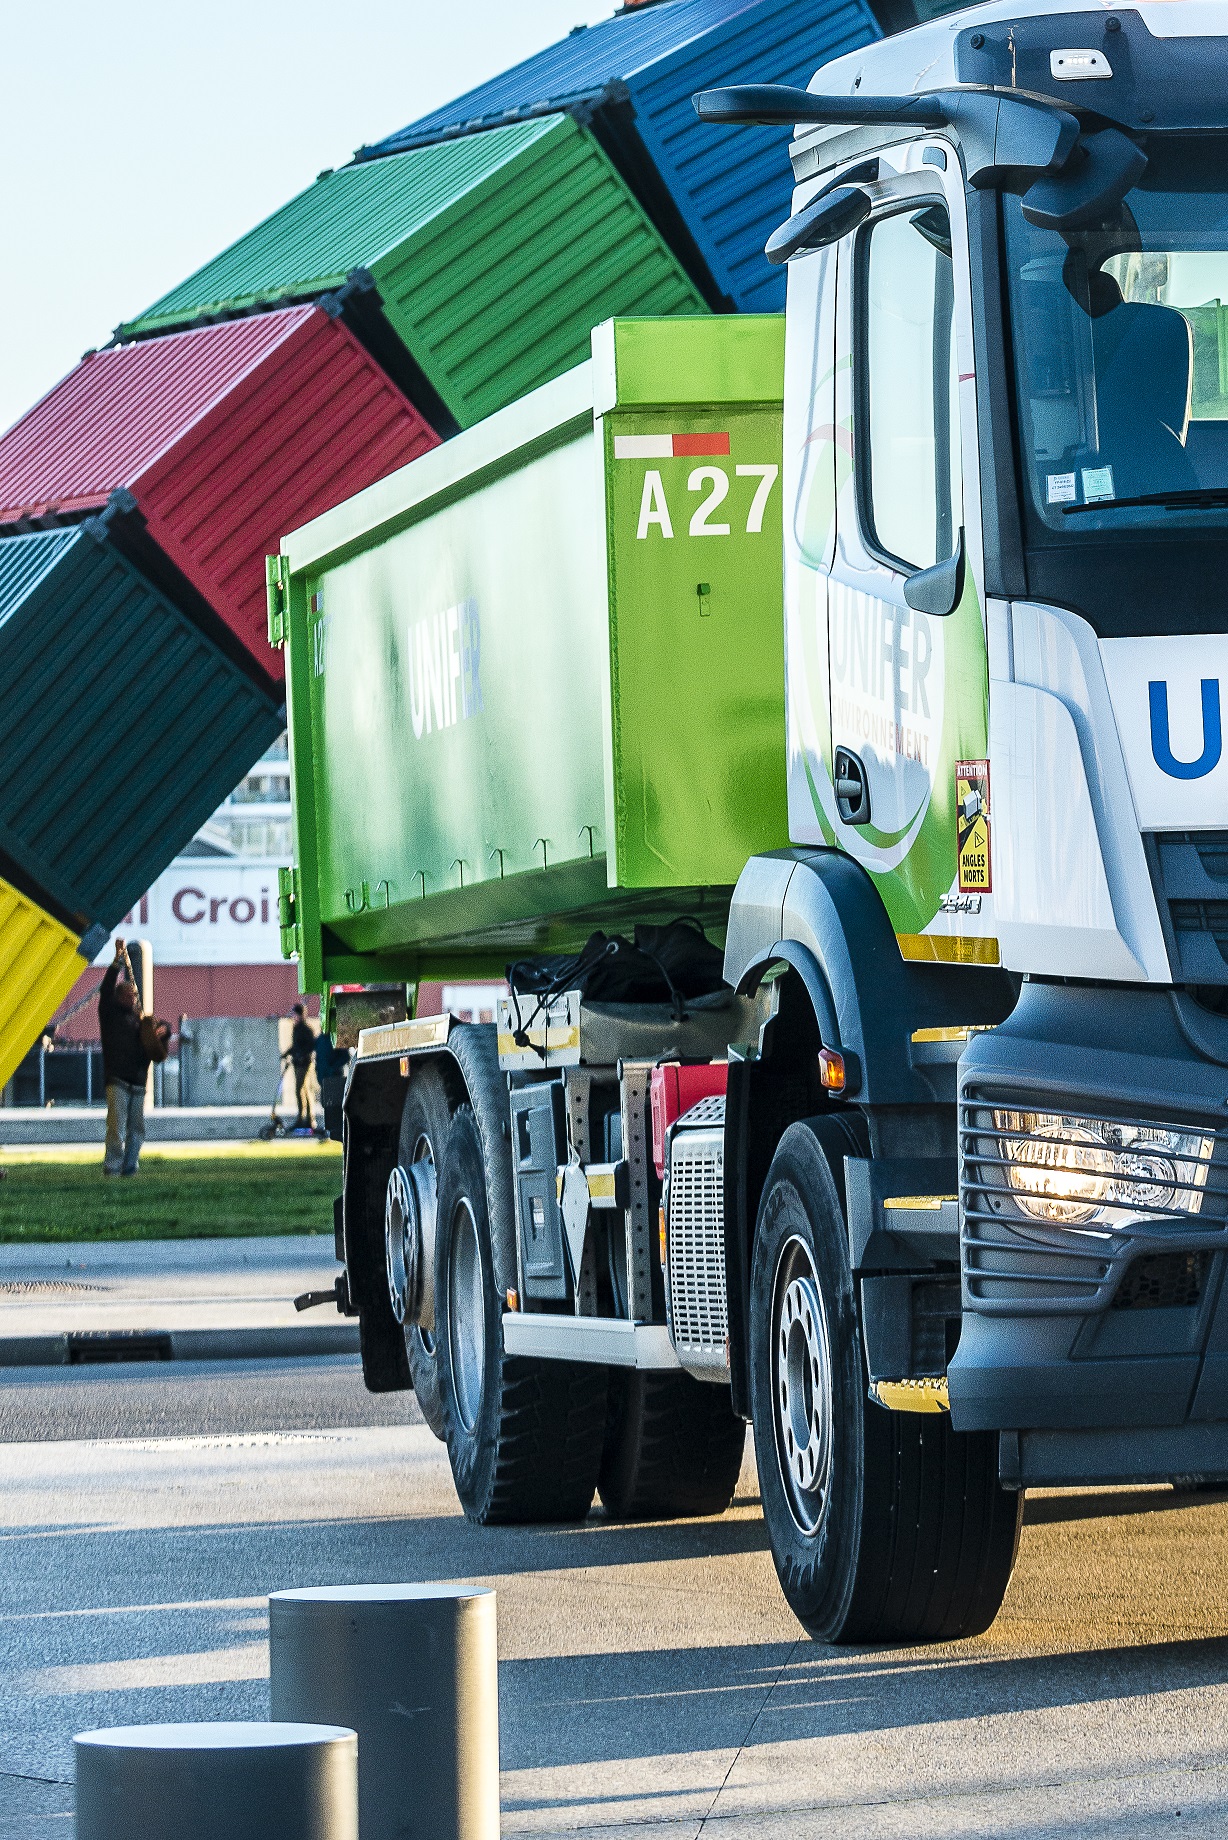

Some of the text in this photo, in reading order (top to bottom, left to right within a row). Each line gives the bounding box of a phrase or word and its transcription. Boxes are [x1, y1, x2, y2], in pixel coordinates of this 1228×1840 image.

[636, 463, 779, 540] A27
[407, 595, 485, 740] UNIFER
[831, 580, 932, 720] UNIFER
[832, 694, 931, 767] ENVIRONNEMENT
[962, 853, 986, 868] ANGLES
[963, 869, 985, 883] MORTS
[171, 886, 280, 925] Croi
